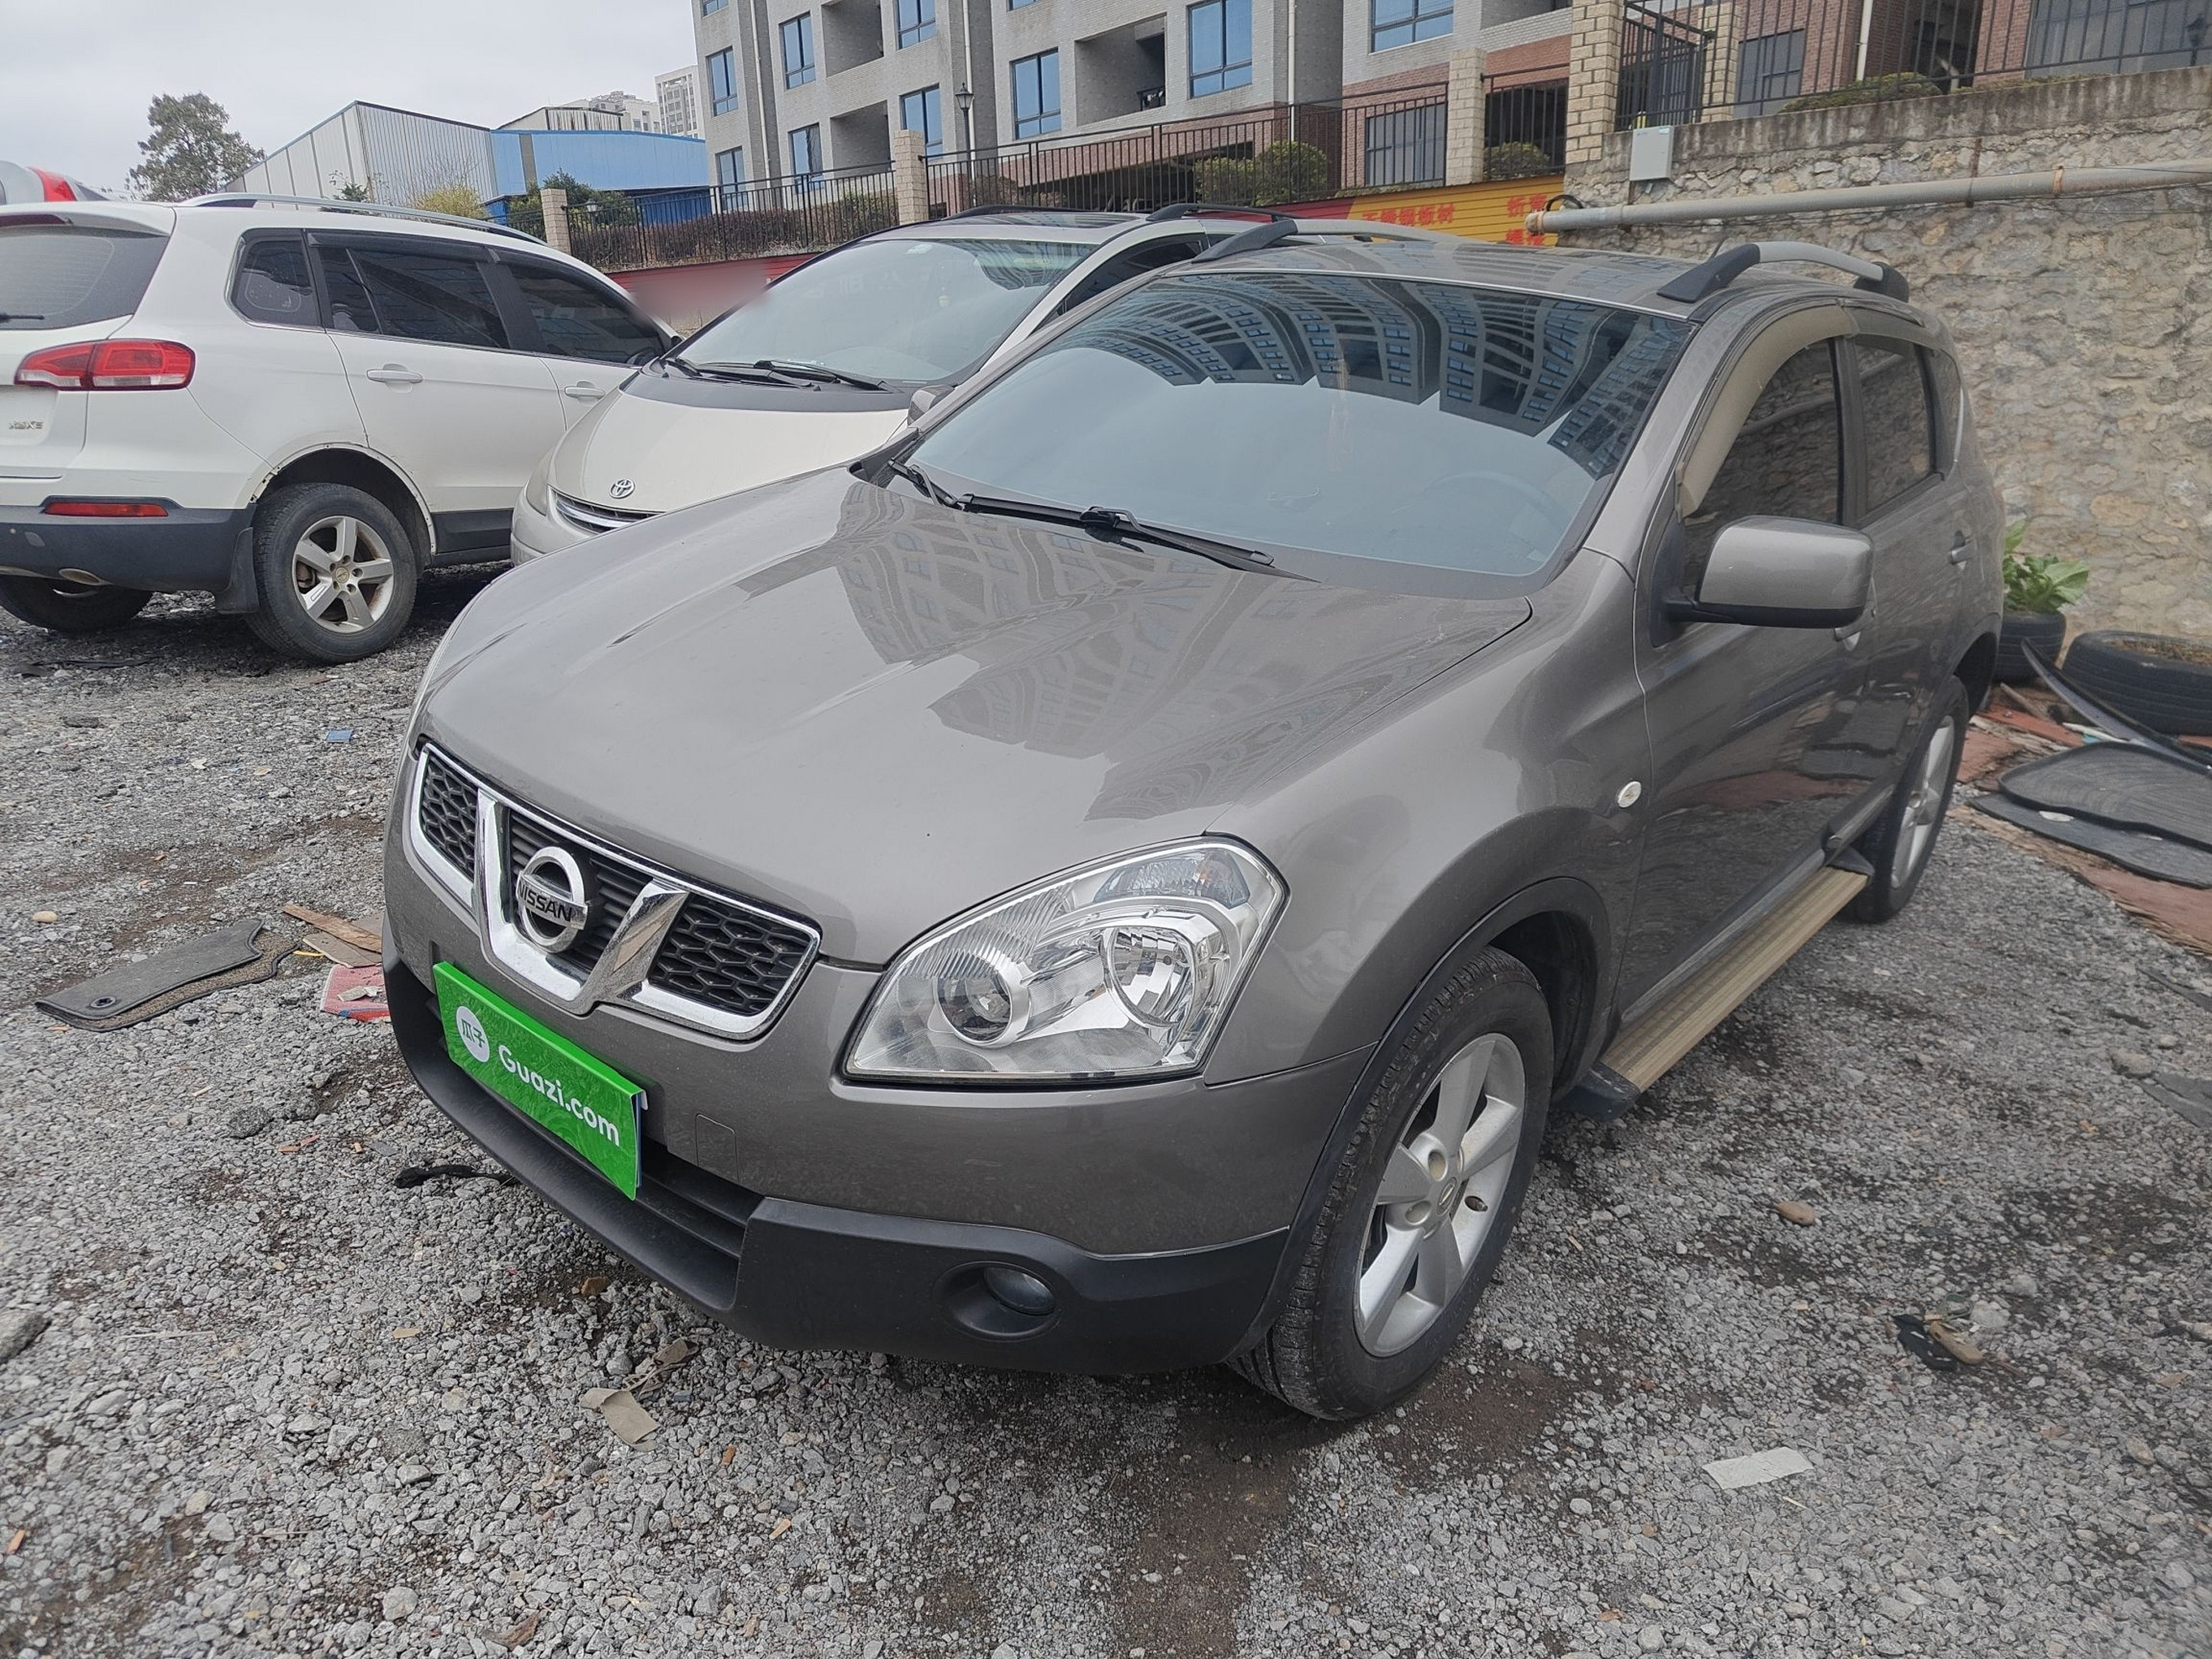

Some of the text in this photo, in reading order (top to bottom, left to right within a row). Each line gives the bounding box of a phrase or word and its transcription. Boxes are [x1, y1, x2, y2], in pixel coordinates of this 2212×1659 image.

[518, 879, 572, 922] NISSAN
[461, 1018, 485, 1048] 瓜子
[498, 1044, 620, 1147] Guazi.com
